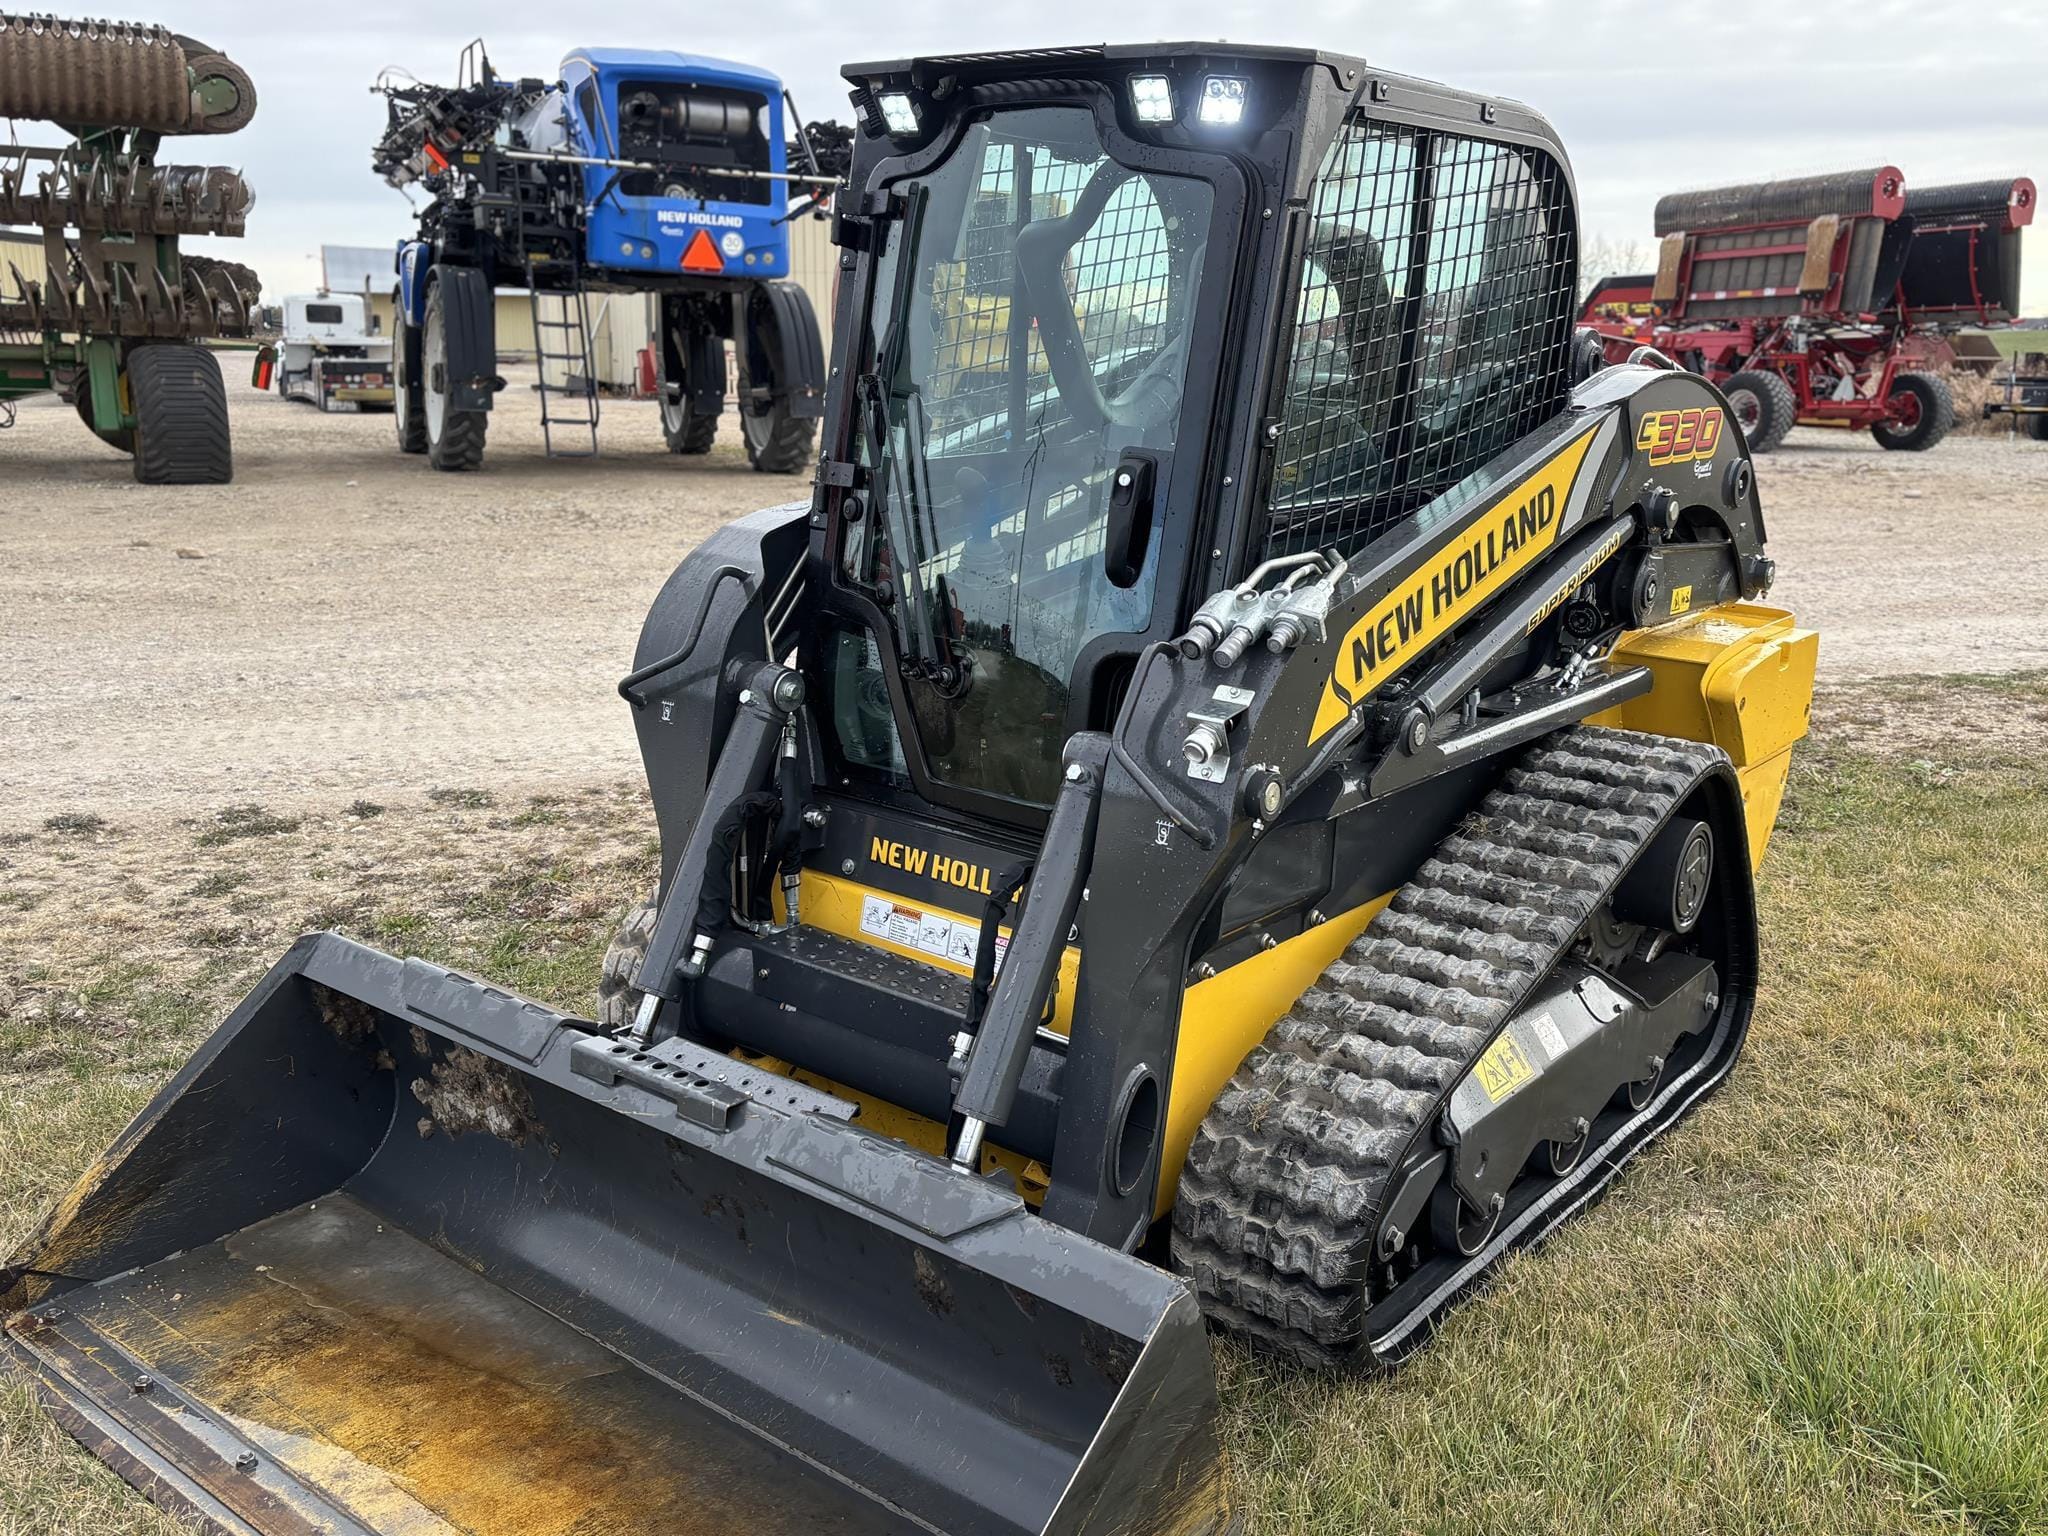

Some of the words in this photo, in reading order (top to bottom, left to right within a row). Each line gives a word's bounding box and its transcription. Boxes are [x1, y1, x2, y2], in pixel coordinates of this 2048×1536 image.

[657, 210, 687, 224] NEW
[688, 212, 743, 228] HOLLAND
[1637, 407, 1724, 465] C330
[1352, 585, 1424, 683] NEW
[1431, 483, 1555, 619] HOLLAND
[1527, 574, 1578, 633] SUPER
[1578, 532, 1620, 585] BOOM
[871, 836, 928, 876] NEW
[931, 854, 1024, 904] HOLL
